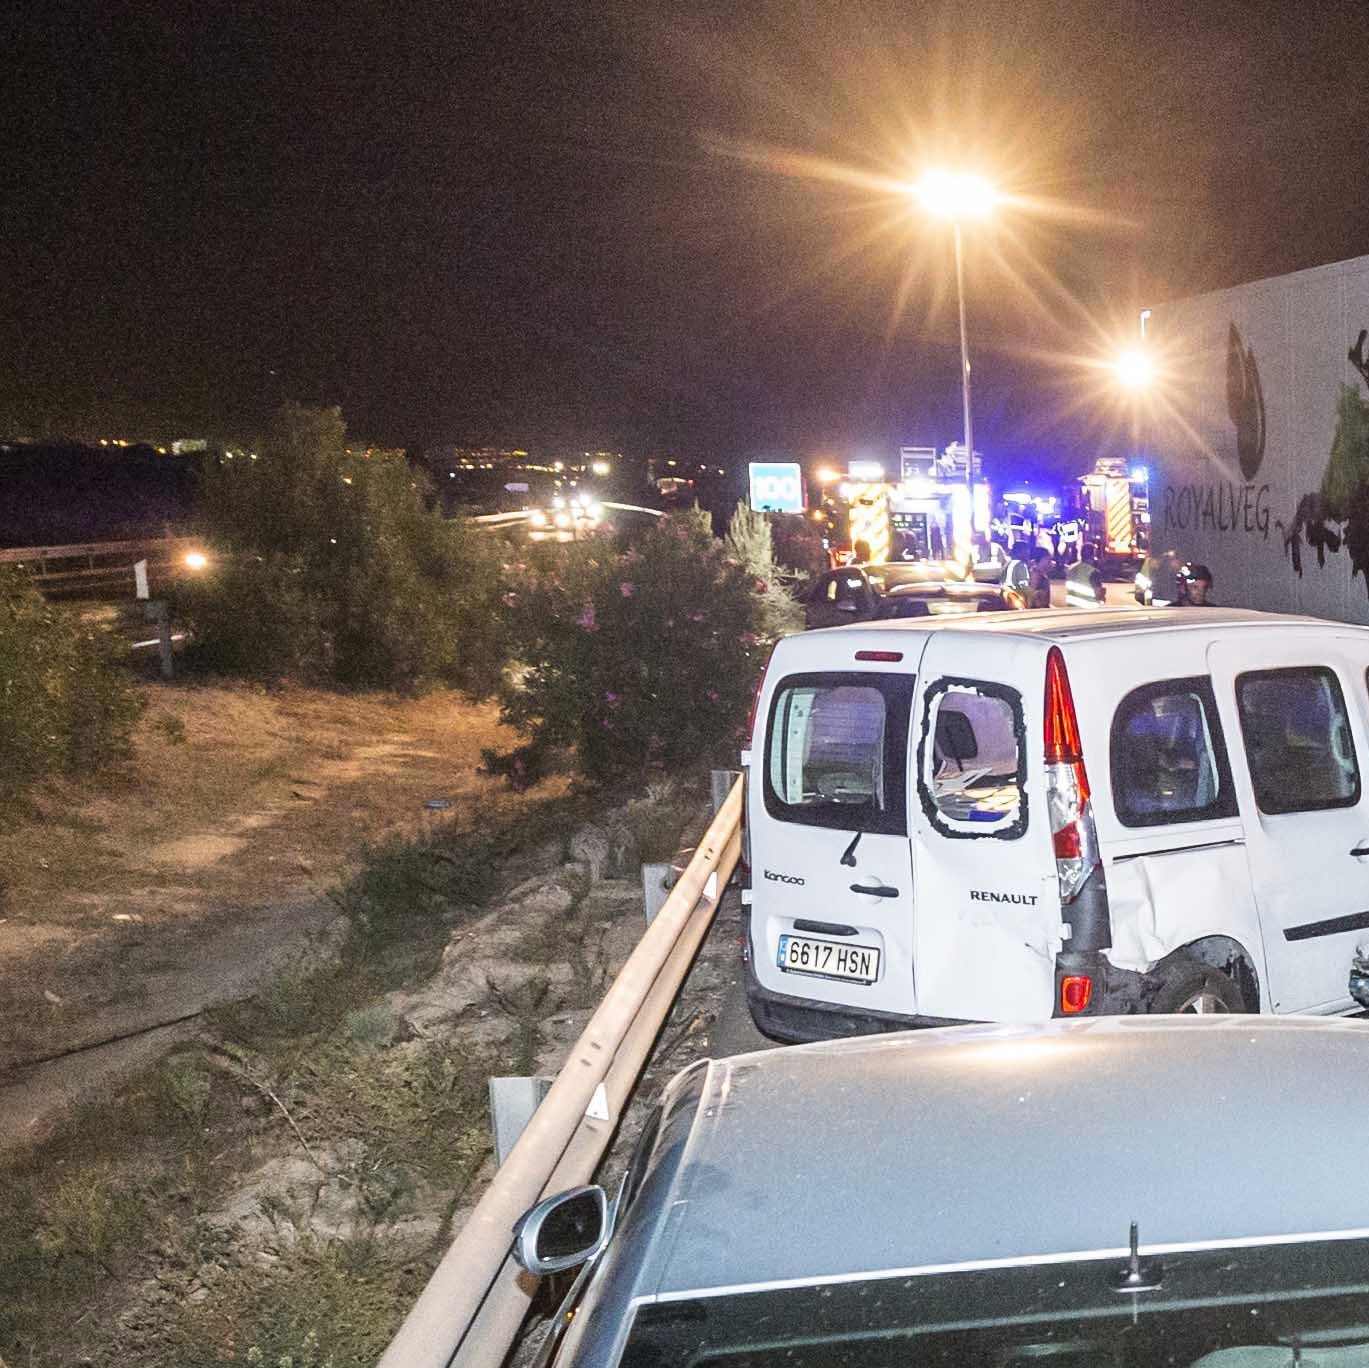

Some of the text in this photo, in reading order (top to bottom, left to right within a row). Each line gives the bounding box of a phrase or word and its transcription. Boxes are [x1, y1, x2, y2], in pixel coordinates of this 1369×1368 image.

[1163, 481, 1270, 540] ROYALVEG
[970, 890, 1038, 906] RENAULT
[789, 941, 833, 970] 6617
[836, 948, 871, 976] HSN
